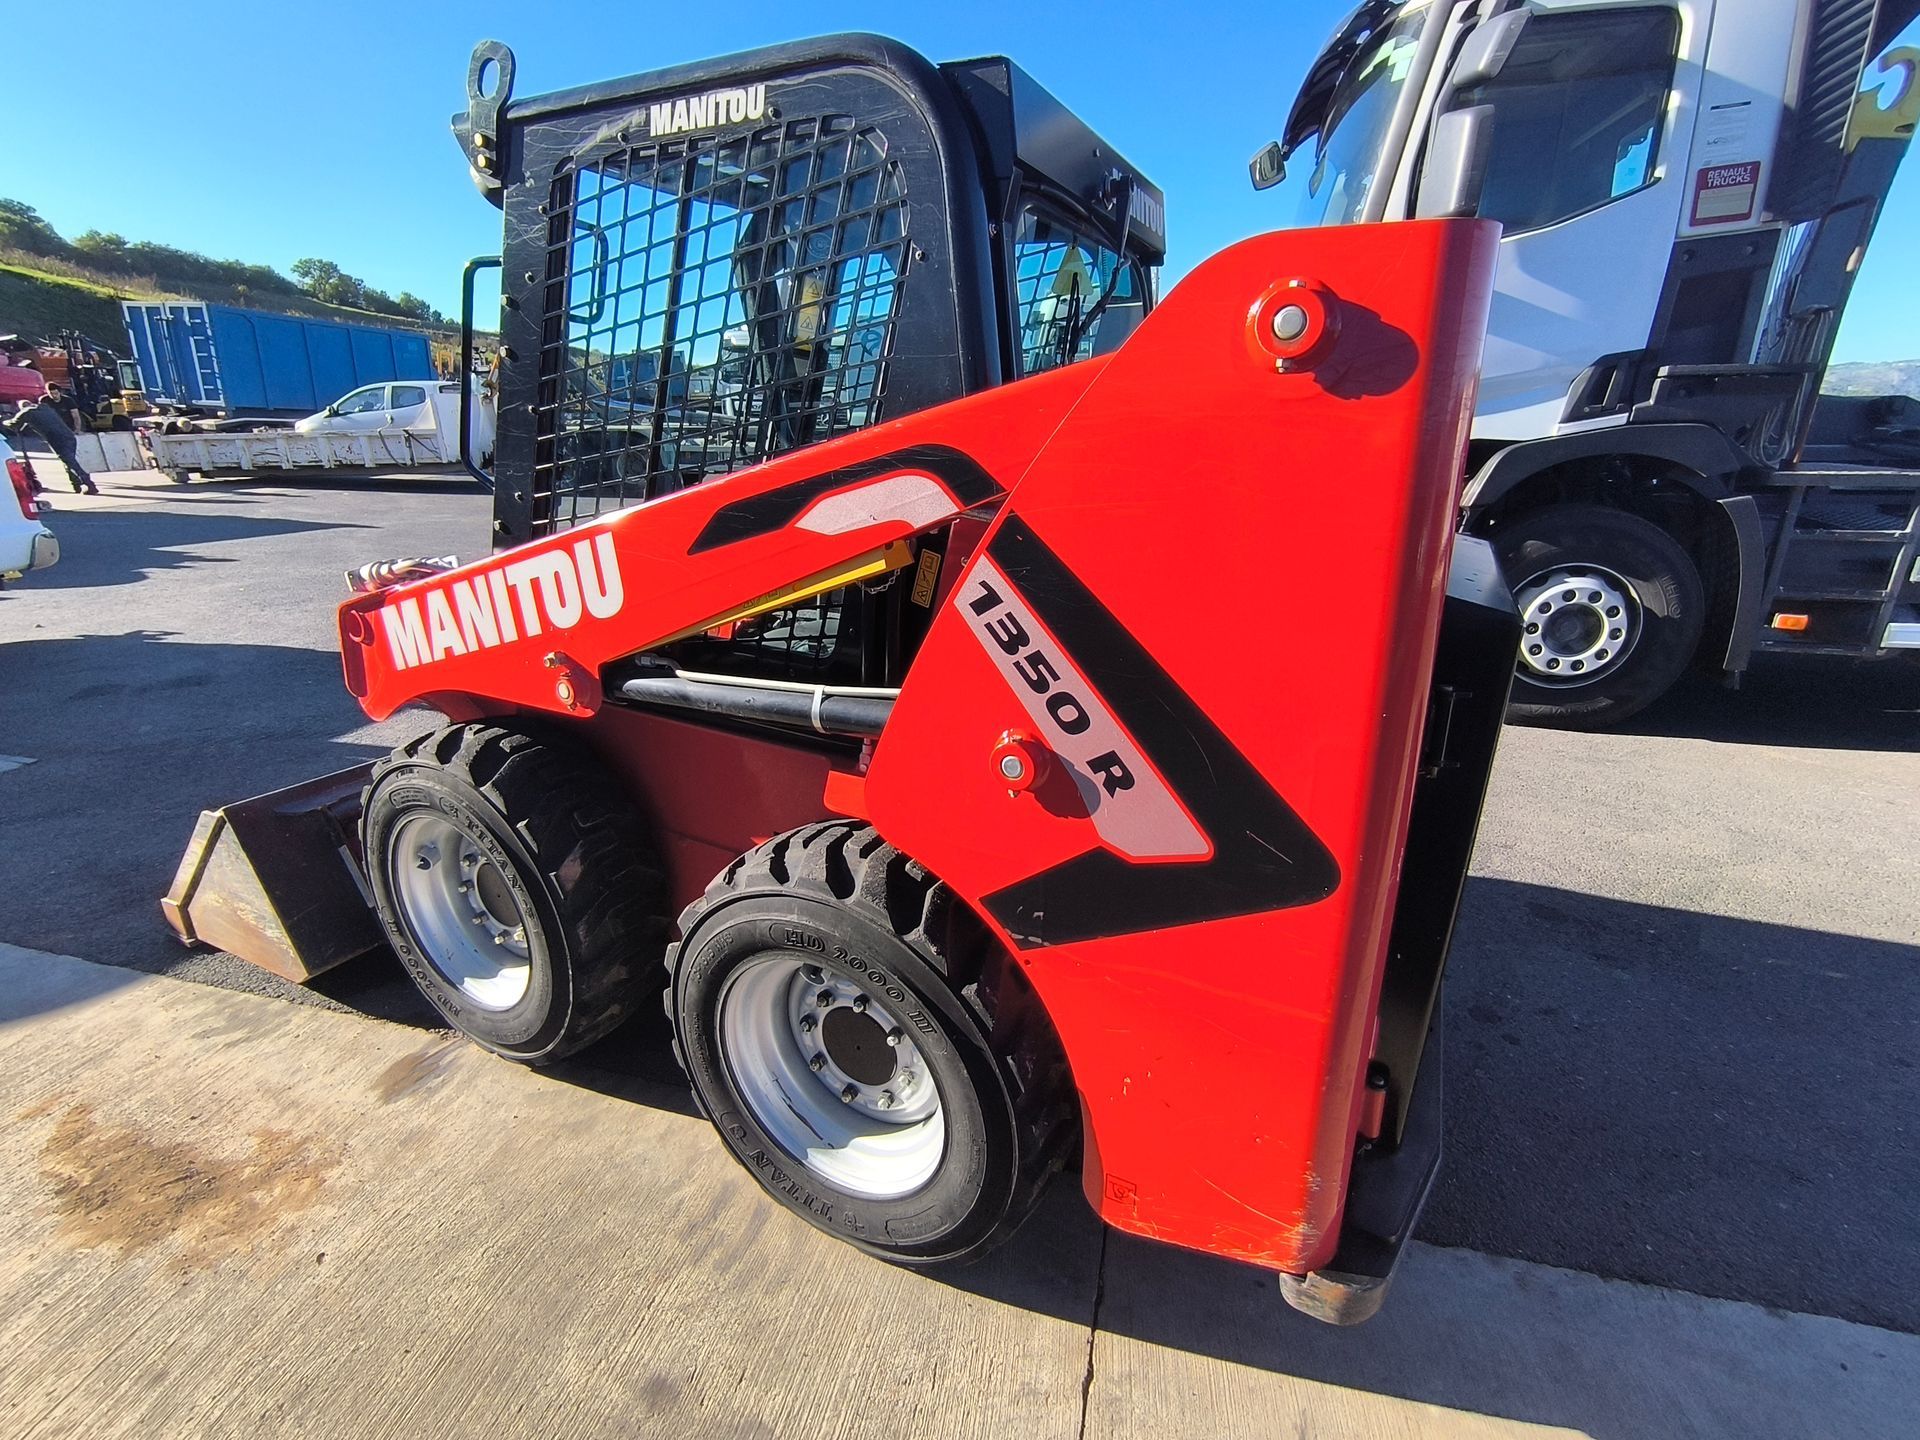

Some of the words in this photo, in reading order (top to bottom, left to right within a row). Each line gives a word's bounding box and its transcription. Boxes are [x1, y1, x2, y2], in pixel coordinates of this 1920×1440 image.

[650, 84, 765, 136] MANITOU
[1707, 165, 1752, 180] RENAULT
[1707, 174, 1751, 187] TRUCKS
[380, 531, 624, 671] MANITOU
[968, 579, 1091, 736] 1350
[1085, 749, 1136, 799] R
[785, 928, 825, 952] HD
[832, 944, 905, 1003] 2000
[749, 1149, 834, 1223] TITAN
